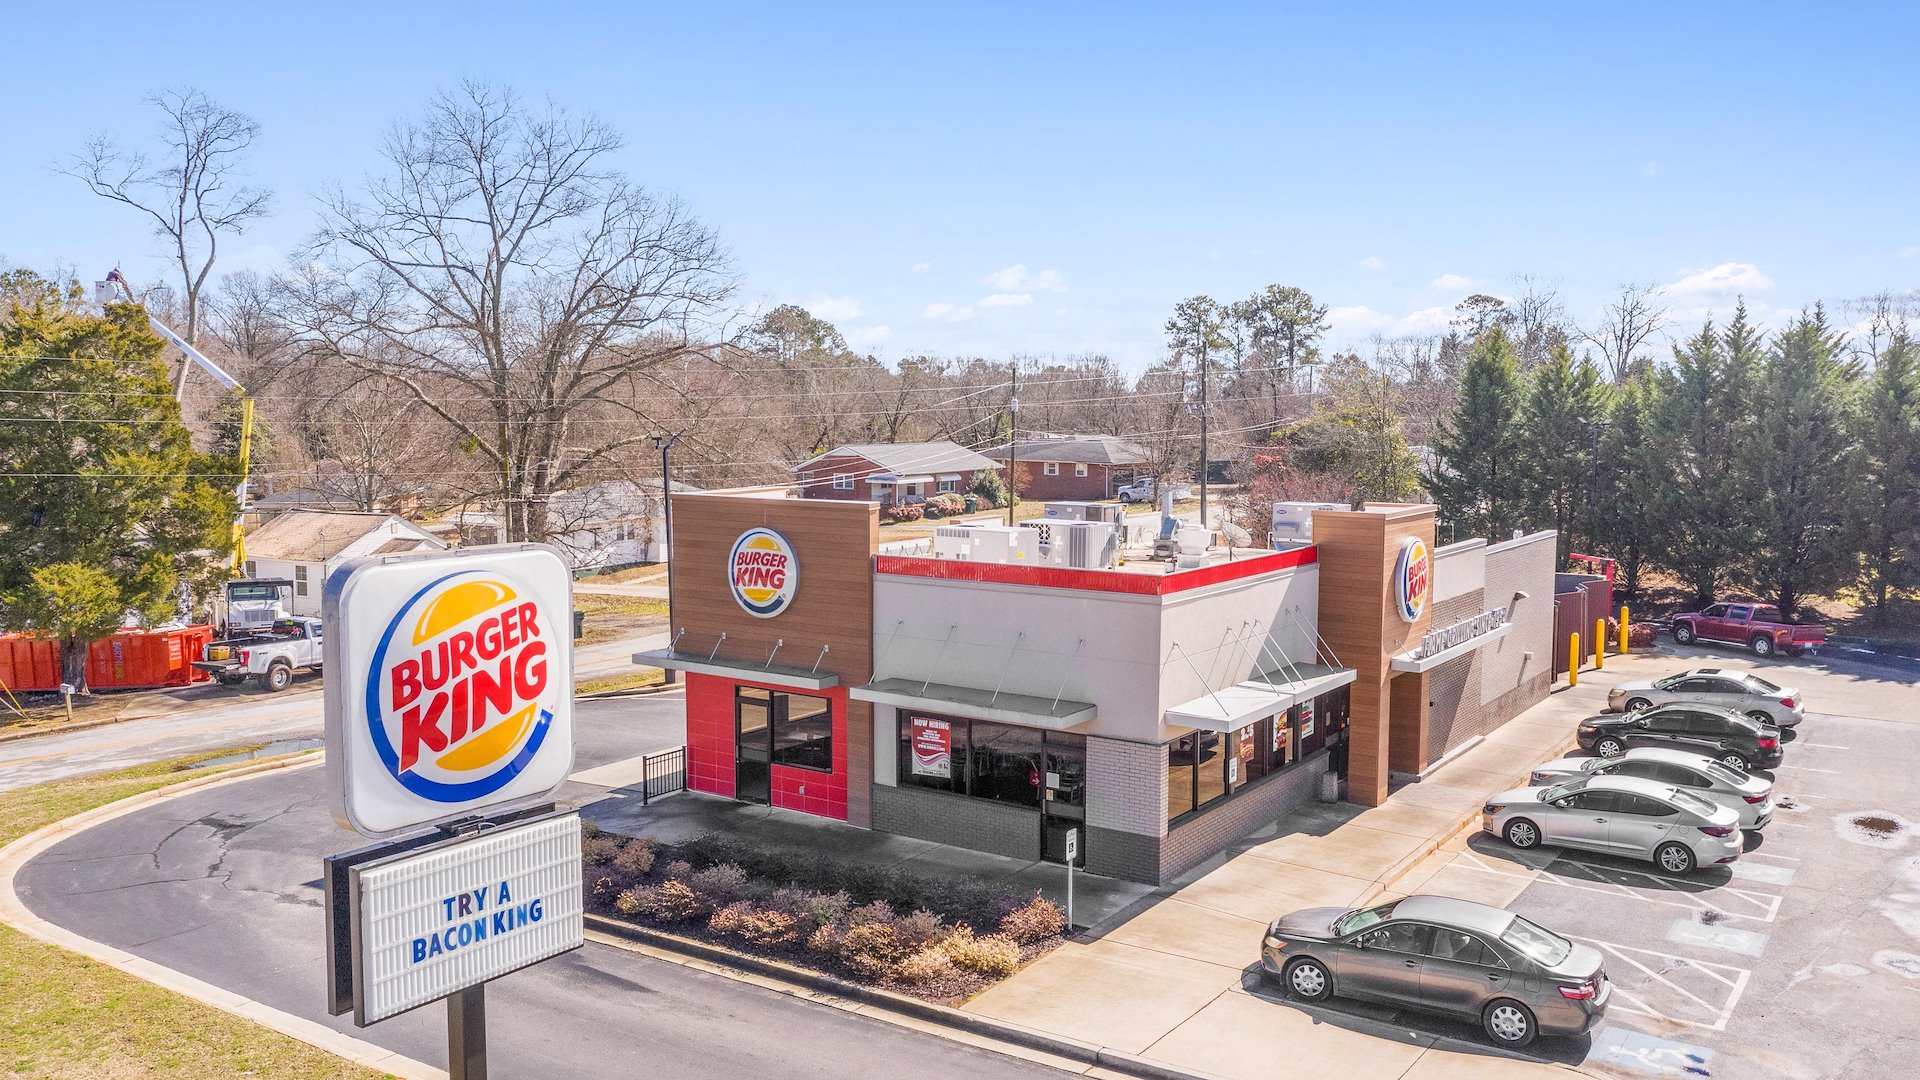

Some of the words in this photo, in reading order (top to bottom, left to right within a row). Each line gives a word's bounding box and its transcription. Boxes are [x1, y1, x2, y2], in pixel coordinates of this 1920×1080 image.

[737, 552, 787, 568] BURGER
[1409, 556, 1427, 581] BURG
[736, 567, 785, 589] KING
[1408, 571, 1427, 601] KIN
[391, 600, 541, 712] BURGER
[398, 640, 548, 773] KING
[913, 718, 928, 727] NOW
[928, 720, 949, 731] HIRING
[443, 885, 486, 921] TRY
[498, 880, 512, 905] A
[412, 915, 488, 964] BACON
[493, 899, 543, 936] KING
